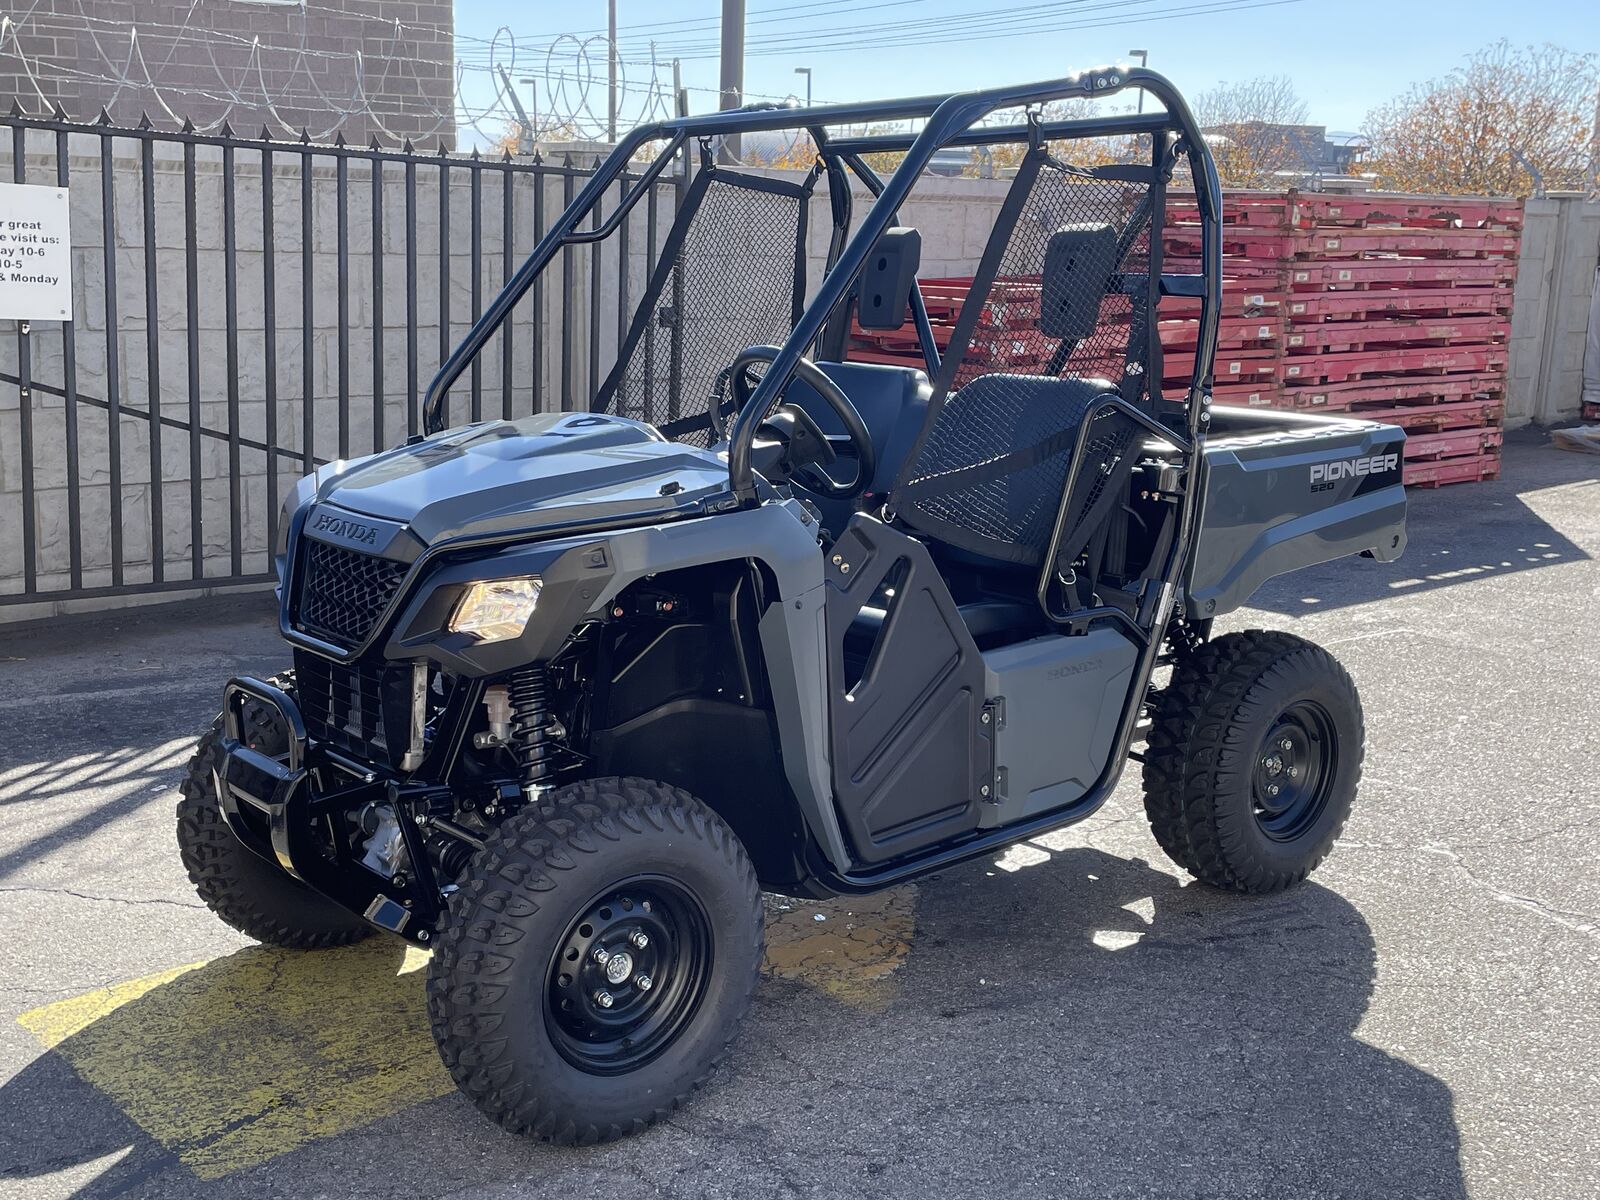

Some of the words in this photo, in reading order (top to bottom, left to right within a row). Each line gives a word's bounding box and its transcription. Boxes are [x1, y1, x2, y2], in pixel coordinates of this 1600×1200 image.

[8, 221, 41, 230] great
[11, 233, 37, 243] visit
[41, 236, 59, 244] us:
[19, 247, 45, 256] 10-6
[11, 273, 58, 285] Monday
[1310, 453, 1398, 483] PIONEER
[313, 514, 379, 545] HONDA
